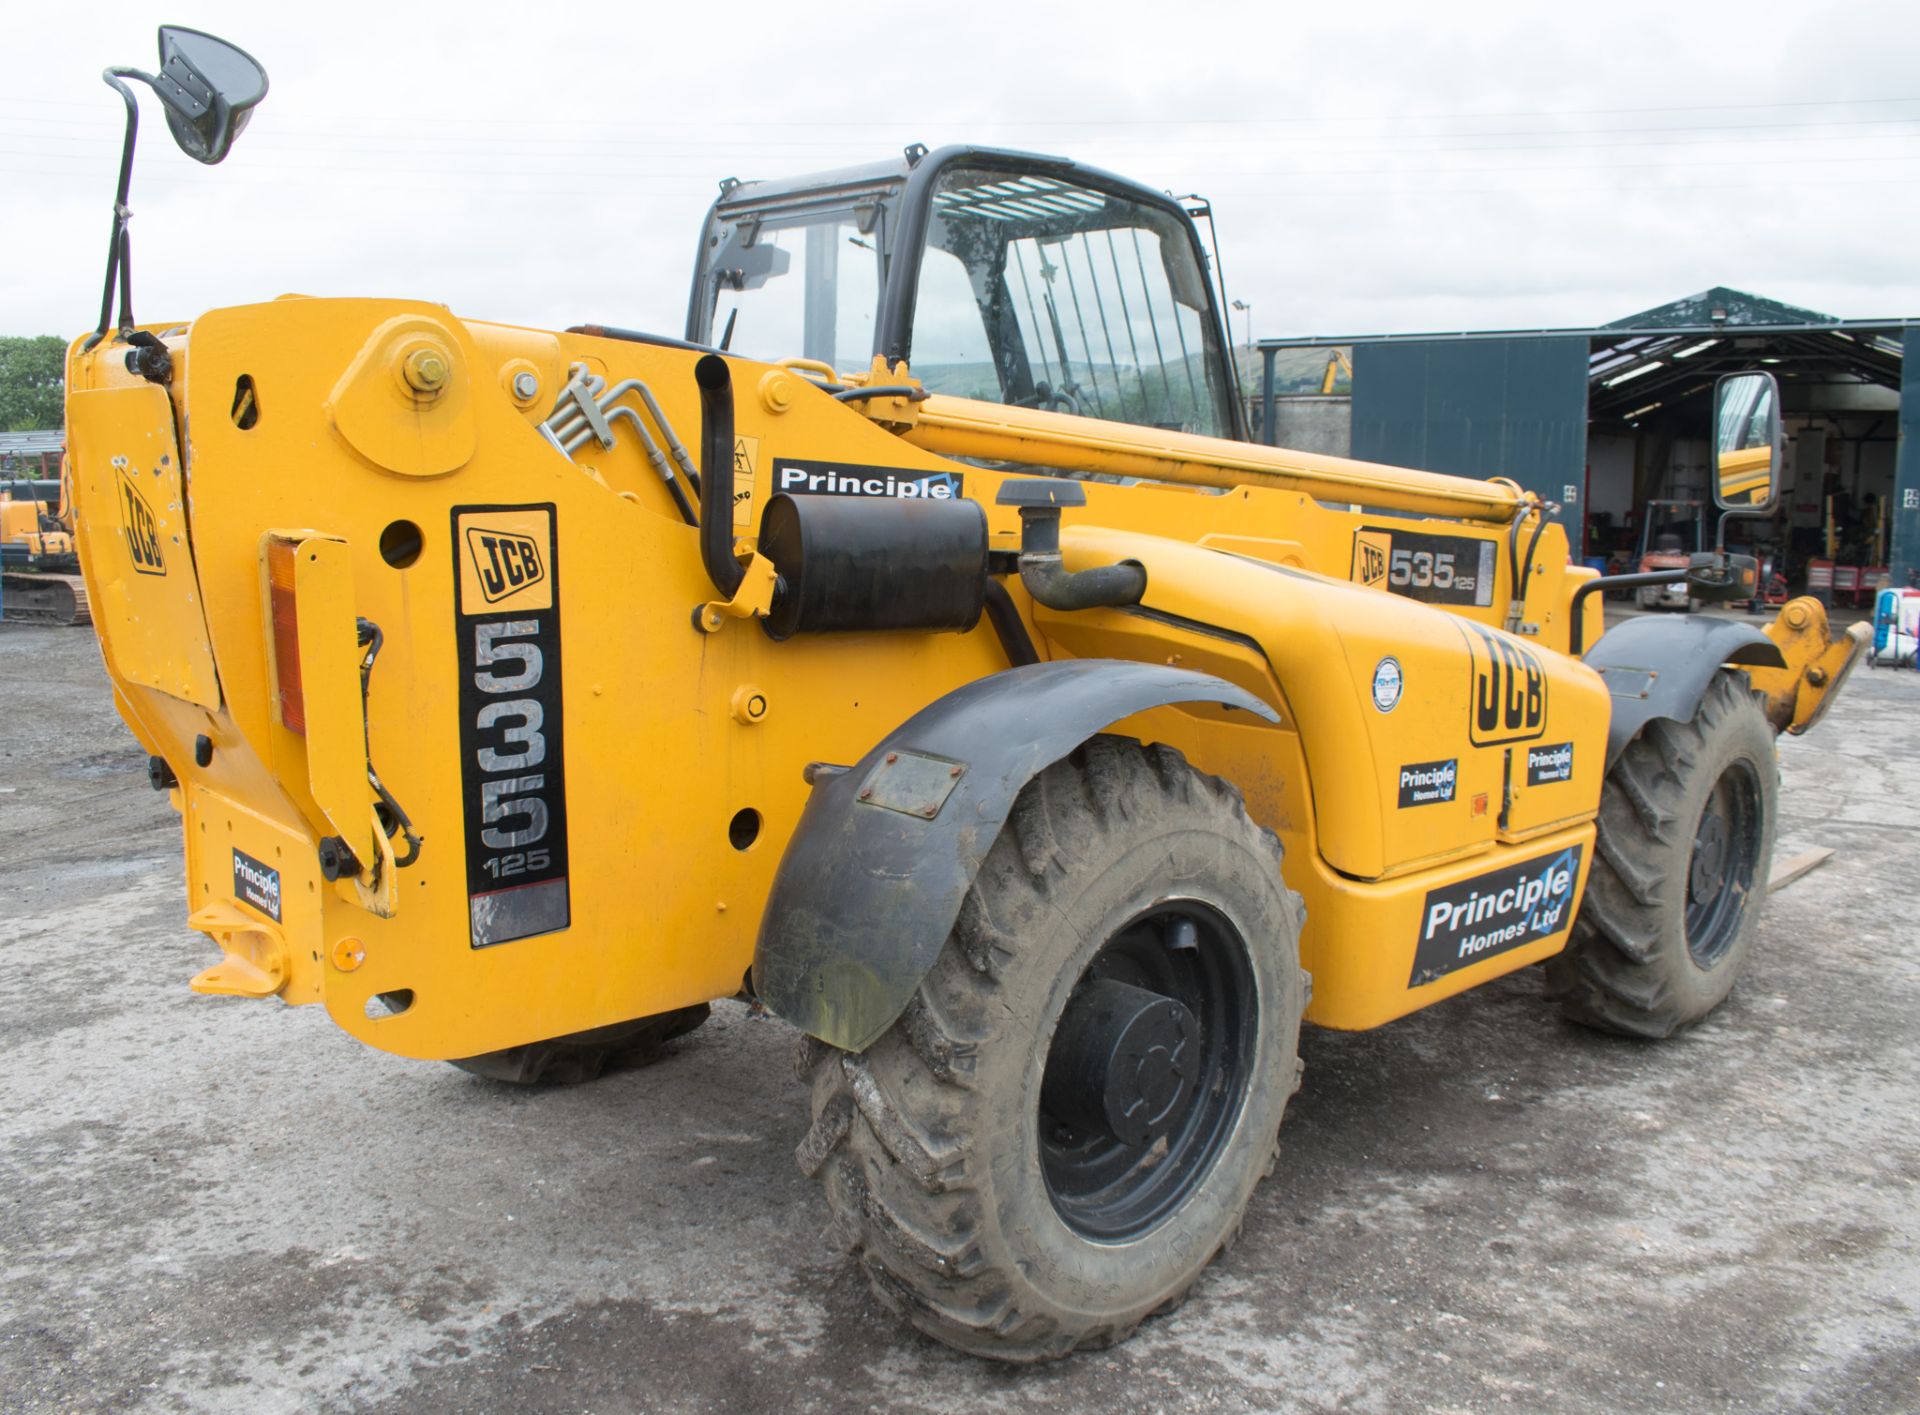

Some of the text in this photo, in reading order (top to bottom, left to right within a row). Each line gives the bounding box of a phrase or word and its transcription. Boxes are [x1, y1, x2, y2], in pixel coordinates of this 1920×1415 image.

[781, 468, 952, 498] Principle
[124, 481, 163, 568] JCB
[481, 535, 539, 595] JCB
[1362, 546, 1476, 590] JCB 535 125
[1465, 620, 1542, 732] JCB
[474, 619, 549, 849] 535
[1400, 766, 1454, 788] Principle
[1528, 748, 1571, 768] Principle
[1413, 786, 1453, 801] Homes Ltd
[234, 855, 279, 897] Principle
[483, 849, 551, 879] 125
[1425, 867, 1570, 940] Principle
[1458, 904, 1561, 958] Homes Ltd
